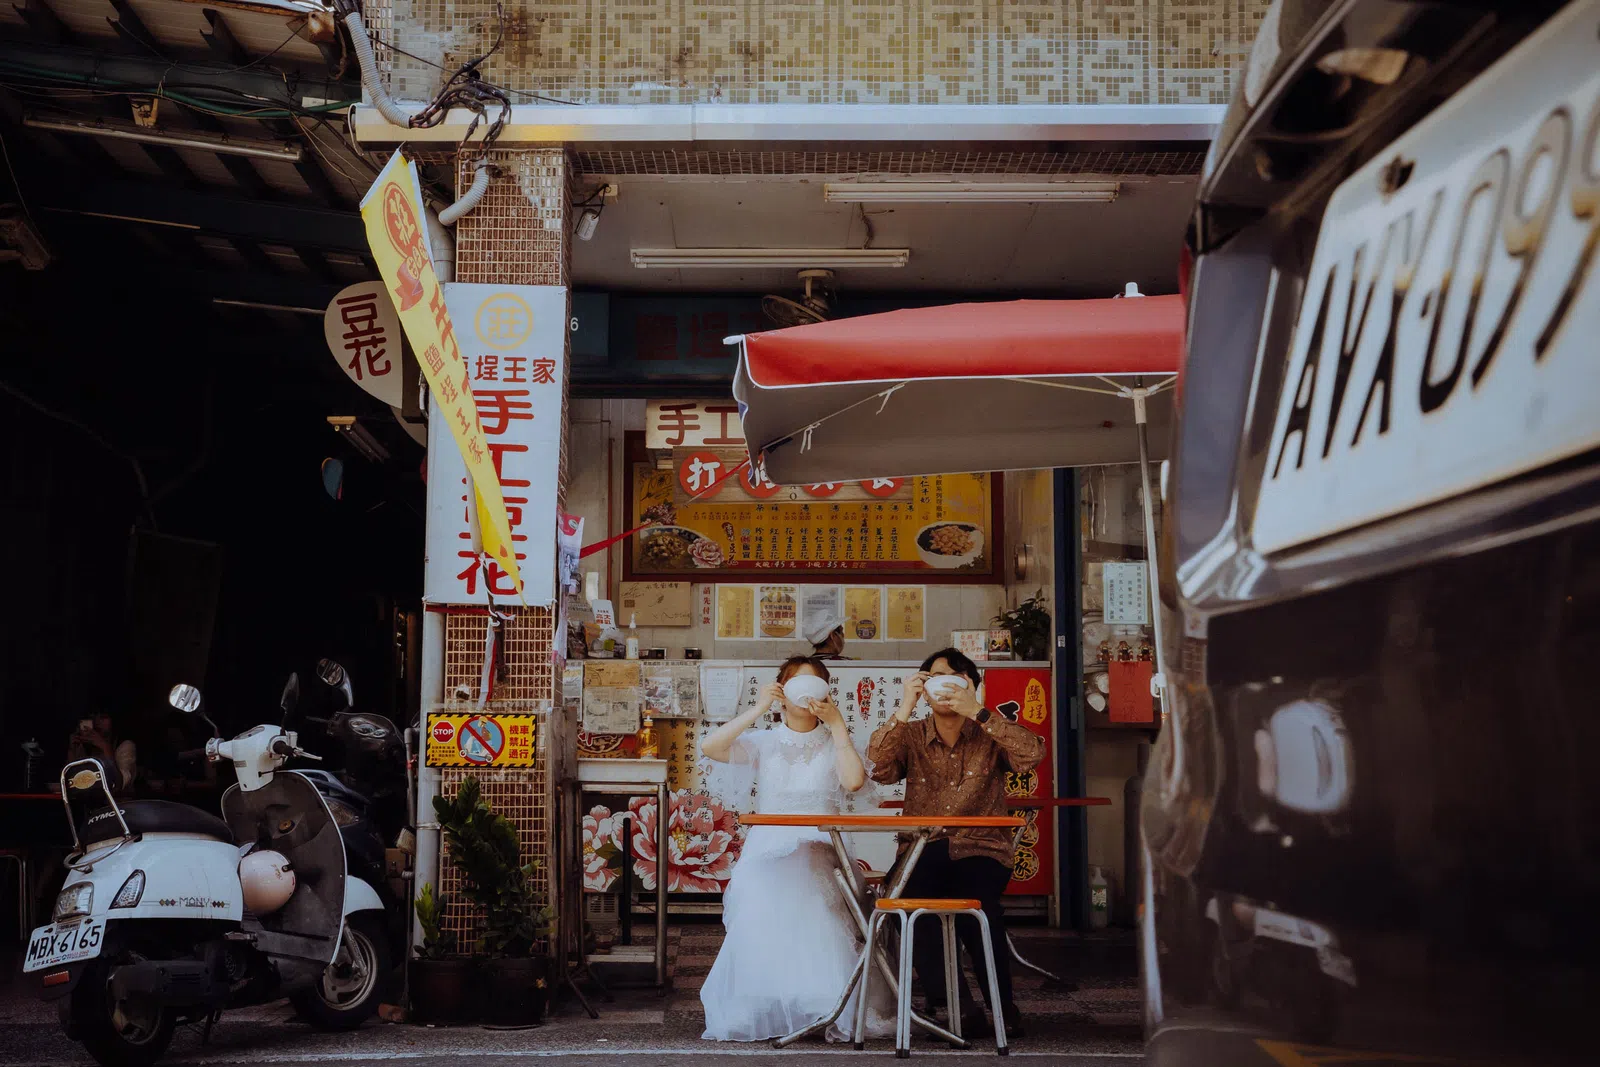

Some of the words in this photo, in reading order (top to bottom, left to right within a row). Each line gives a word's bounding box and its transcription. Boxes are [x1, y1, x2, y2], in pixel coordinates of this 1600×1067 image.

[337, 292, 392, 381] 豆花
[488, 306, 522, 339] 莊
[657, 403, 746, 446] 手工
[702, 586, 712, 625] 請先付款
[1029, 684, 1045, 720] 鹽埕
[509, 725, 529, 735] 機車
[509, 737, 529, 747] 禁止
[509, 749, 529, 759] 通行
